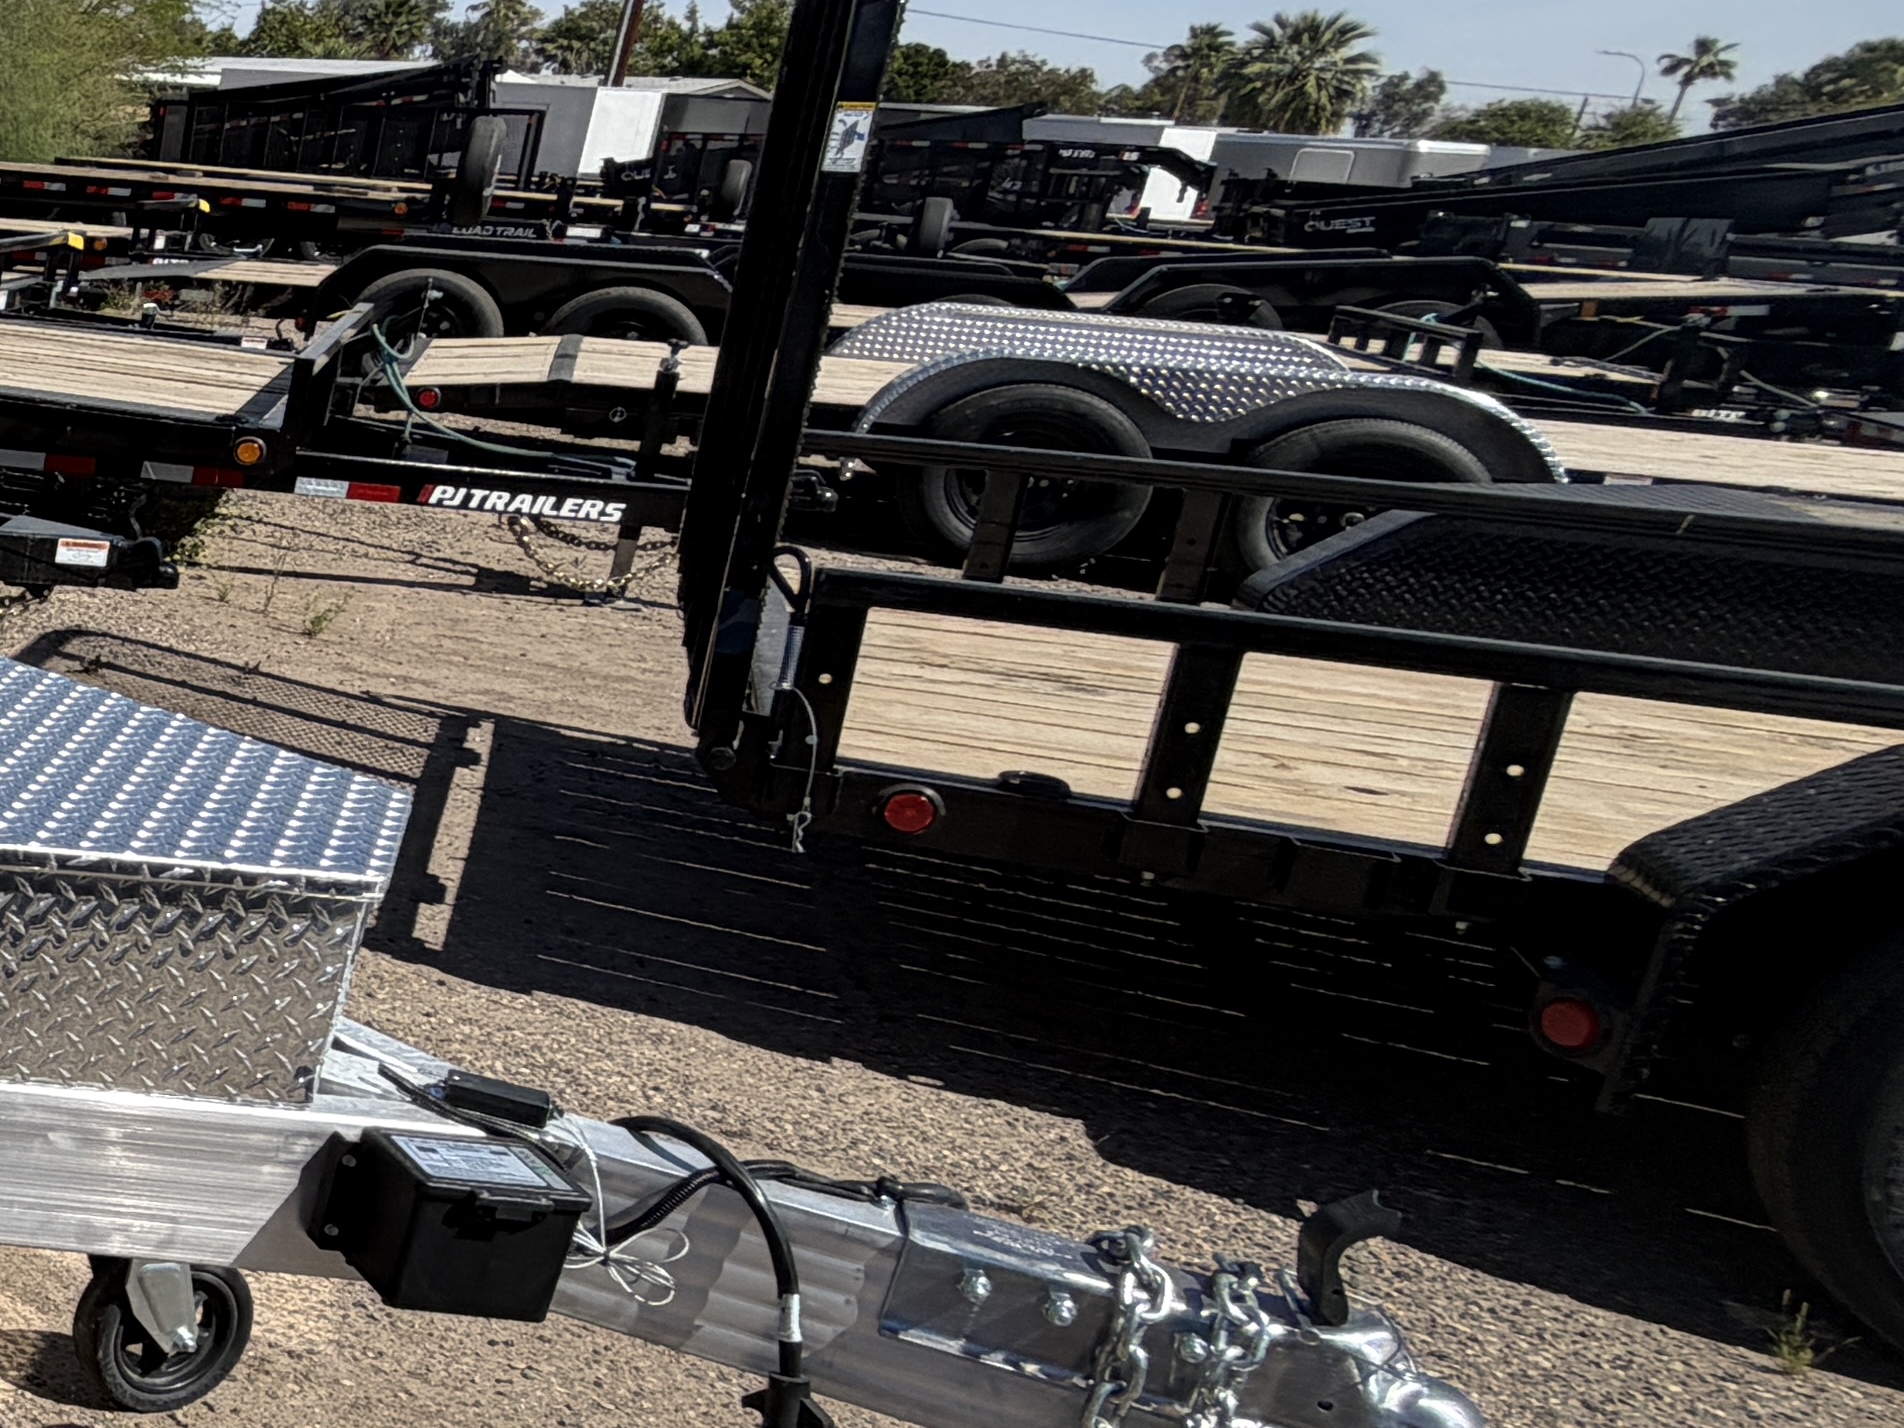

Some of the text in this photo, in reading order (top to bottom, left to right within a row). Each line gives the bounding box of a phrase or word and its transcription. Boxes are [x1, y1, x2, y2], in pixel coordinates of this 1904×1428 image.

[495, 227, 537, 239] TRAIL
[428, 484, 627, 522] PJ TRAILERS
